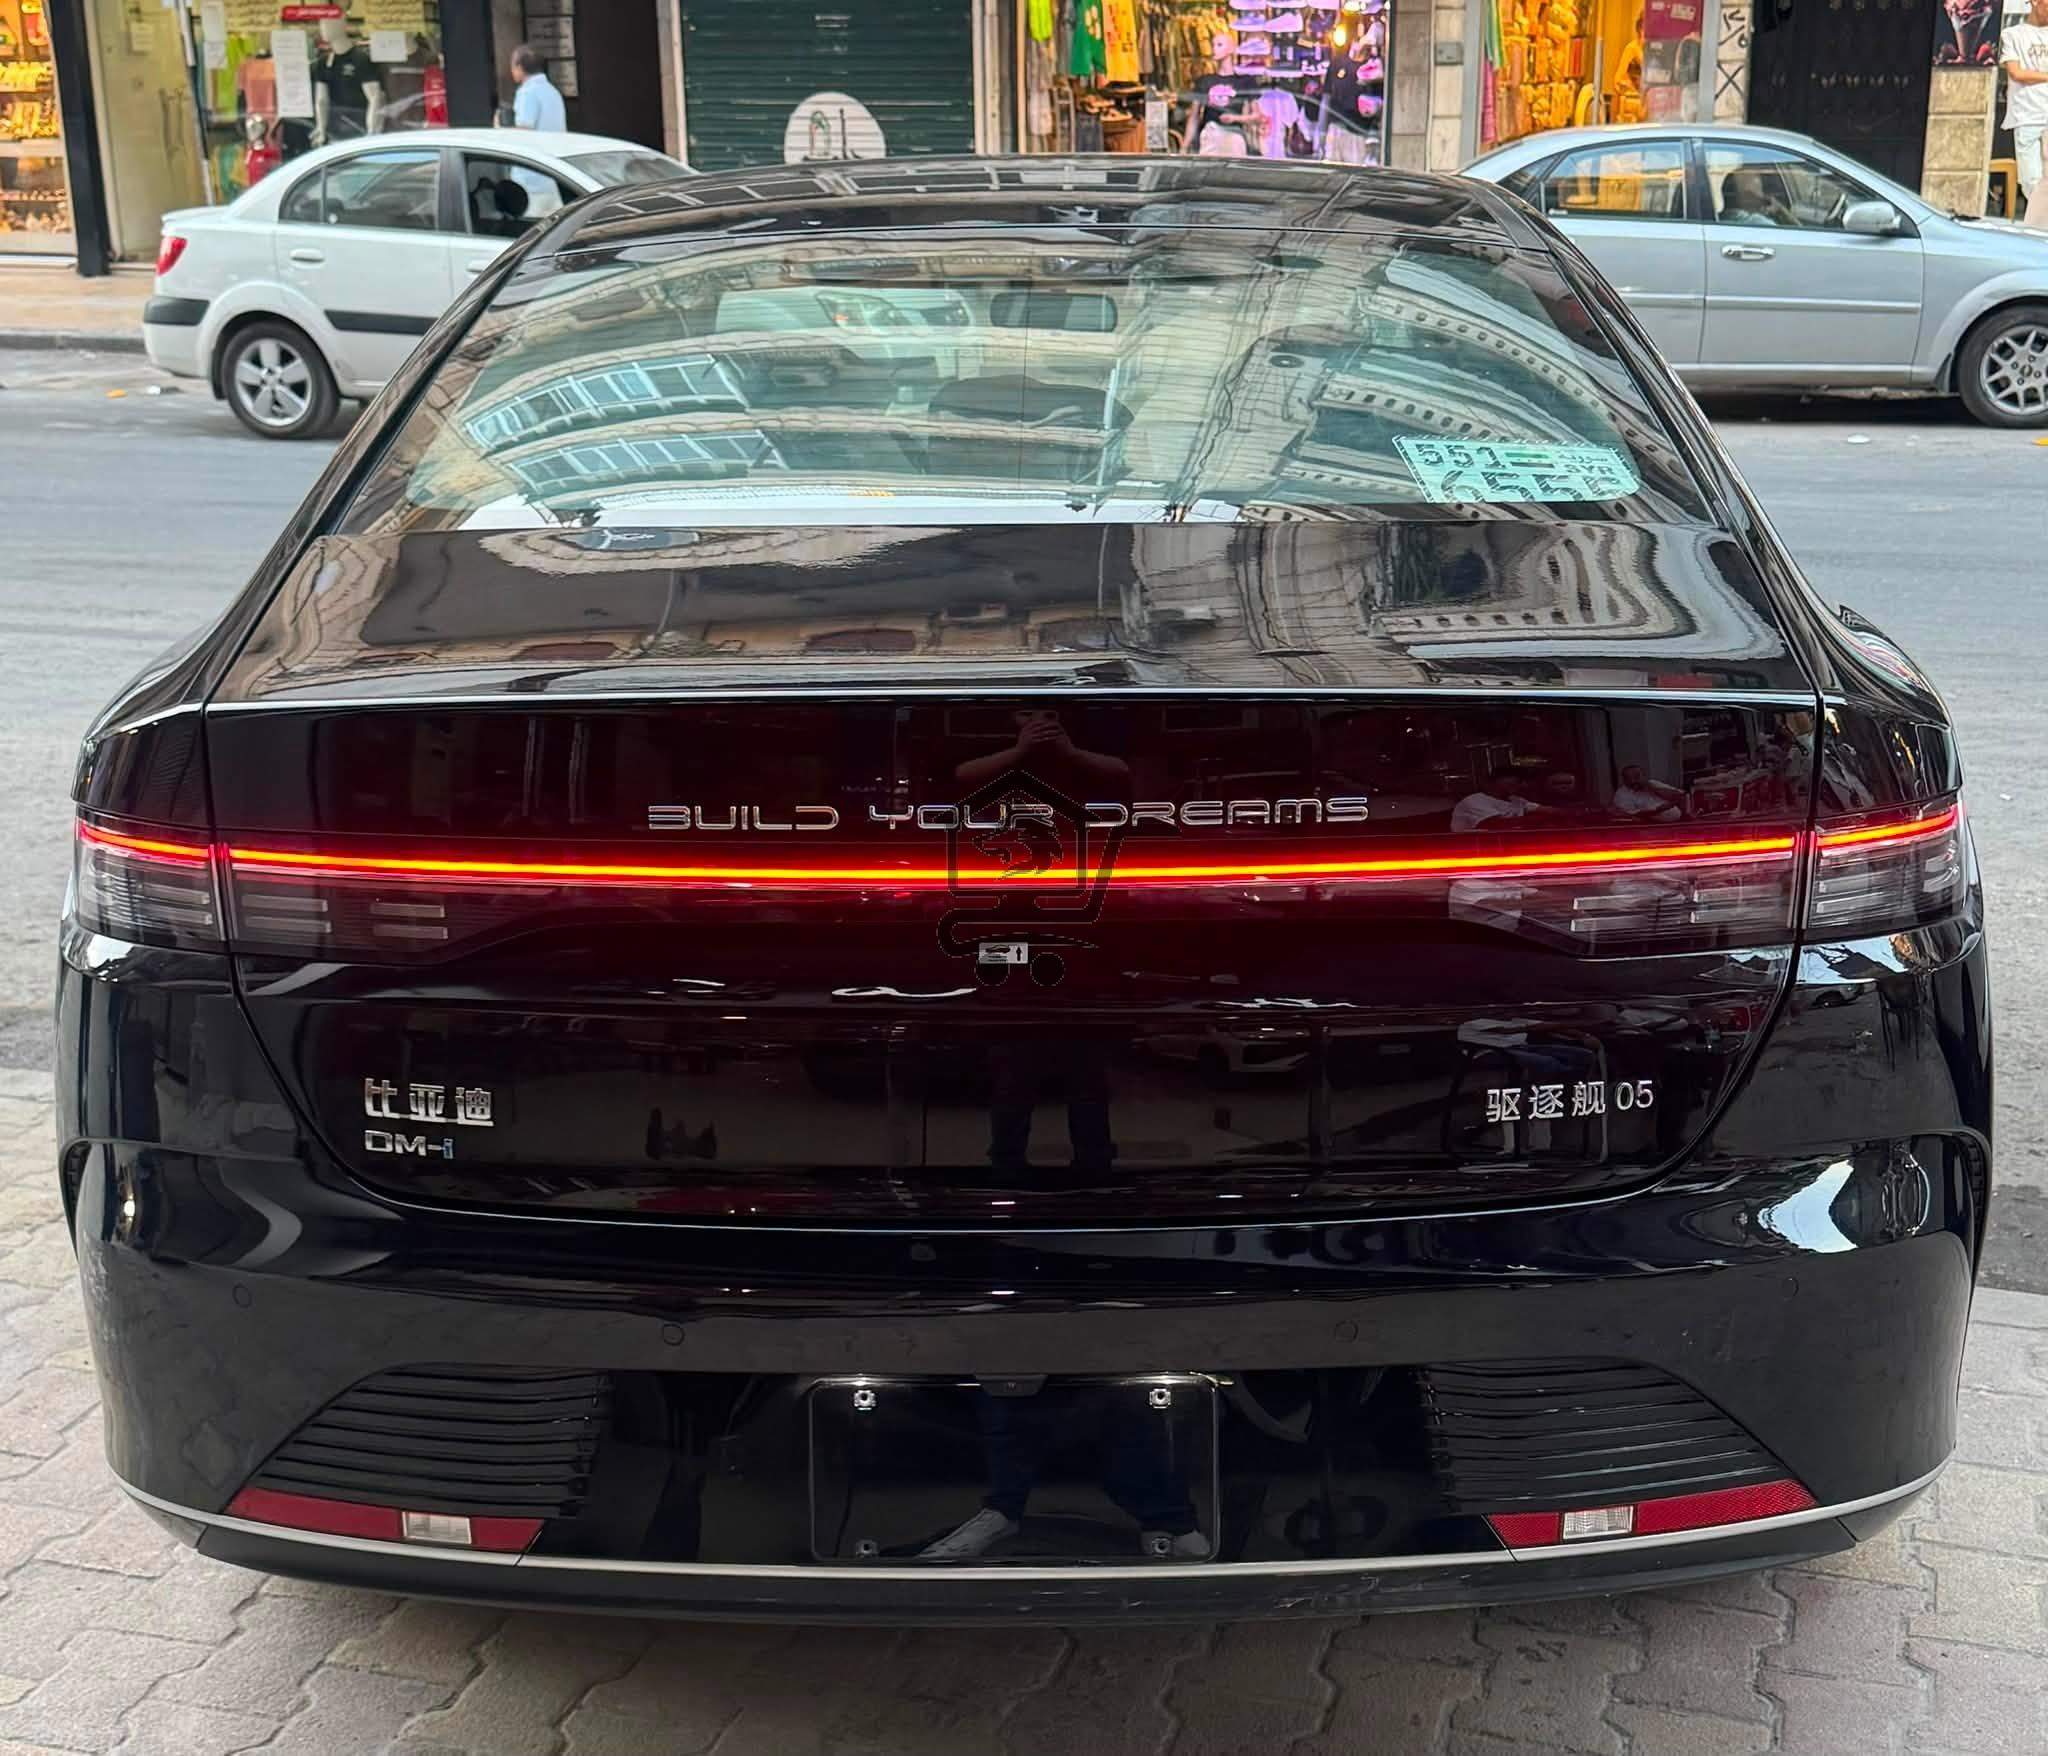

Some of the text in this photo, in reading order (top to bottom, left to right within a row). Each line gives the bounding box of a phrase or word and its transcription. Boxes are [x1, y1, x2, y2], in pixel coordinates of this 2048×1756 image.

[1415, 444, 1506, 468] 551
[1563, 464, 1615, 475] SYR
[647, 796, 1369, 831] BUILD YOUR DREAMS
[364, 1077, 495, 1127] 比亚迪
[1486, 1079, 1654, 1123] 驱逐舰 05
[364, 1129, 454, 1159] DM-i
